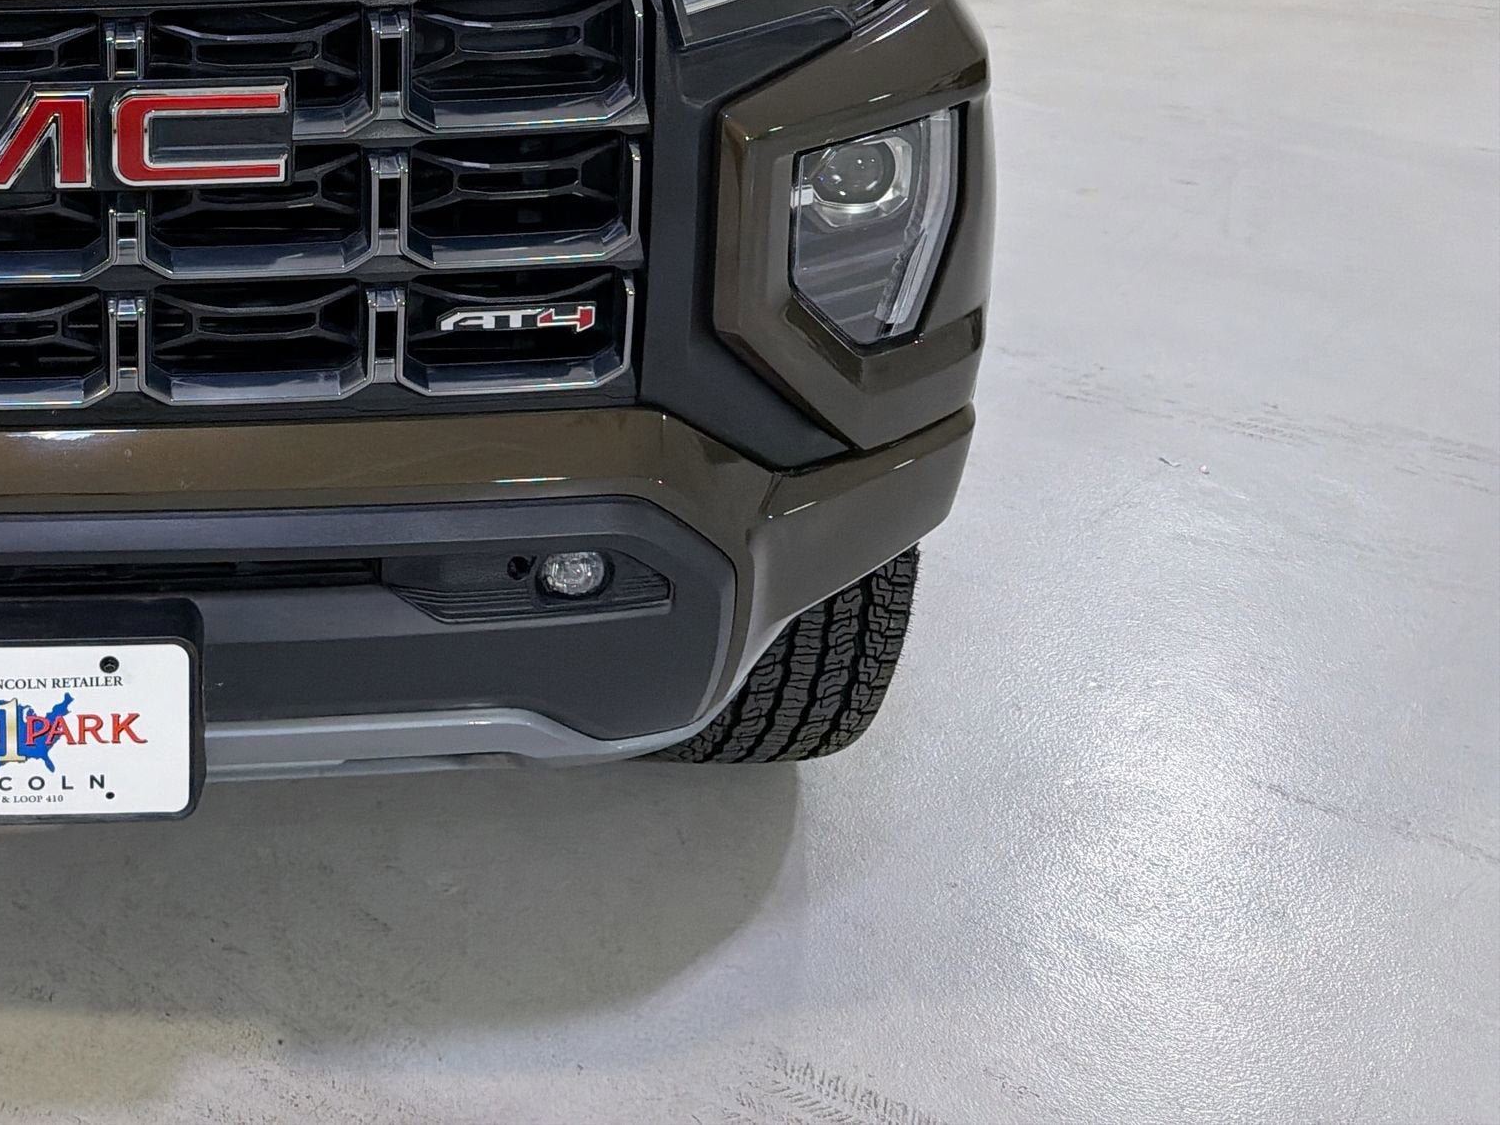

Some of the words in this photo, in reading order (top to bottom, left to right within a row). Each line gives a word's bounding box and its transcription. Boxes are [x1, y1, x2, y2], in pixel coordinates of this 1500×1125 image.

[440, 305, 596, 333] AT4
[52, 675, 124, 689] RETAILER
[26, 713, 148, 747] PARK
[1, 791, 11, 804] &
[13, 790, 43, 803] LOOP
[45, 790, 64, 803] 410
